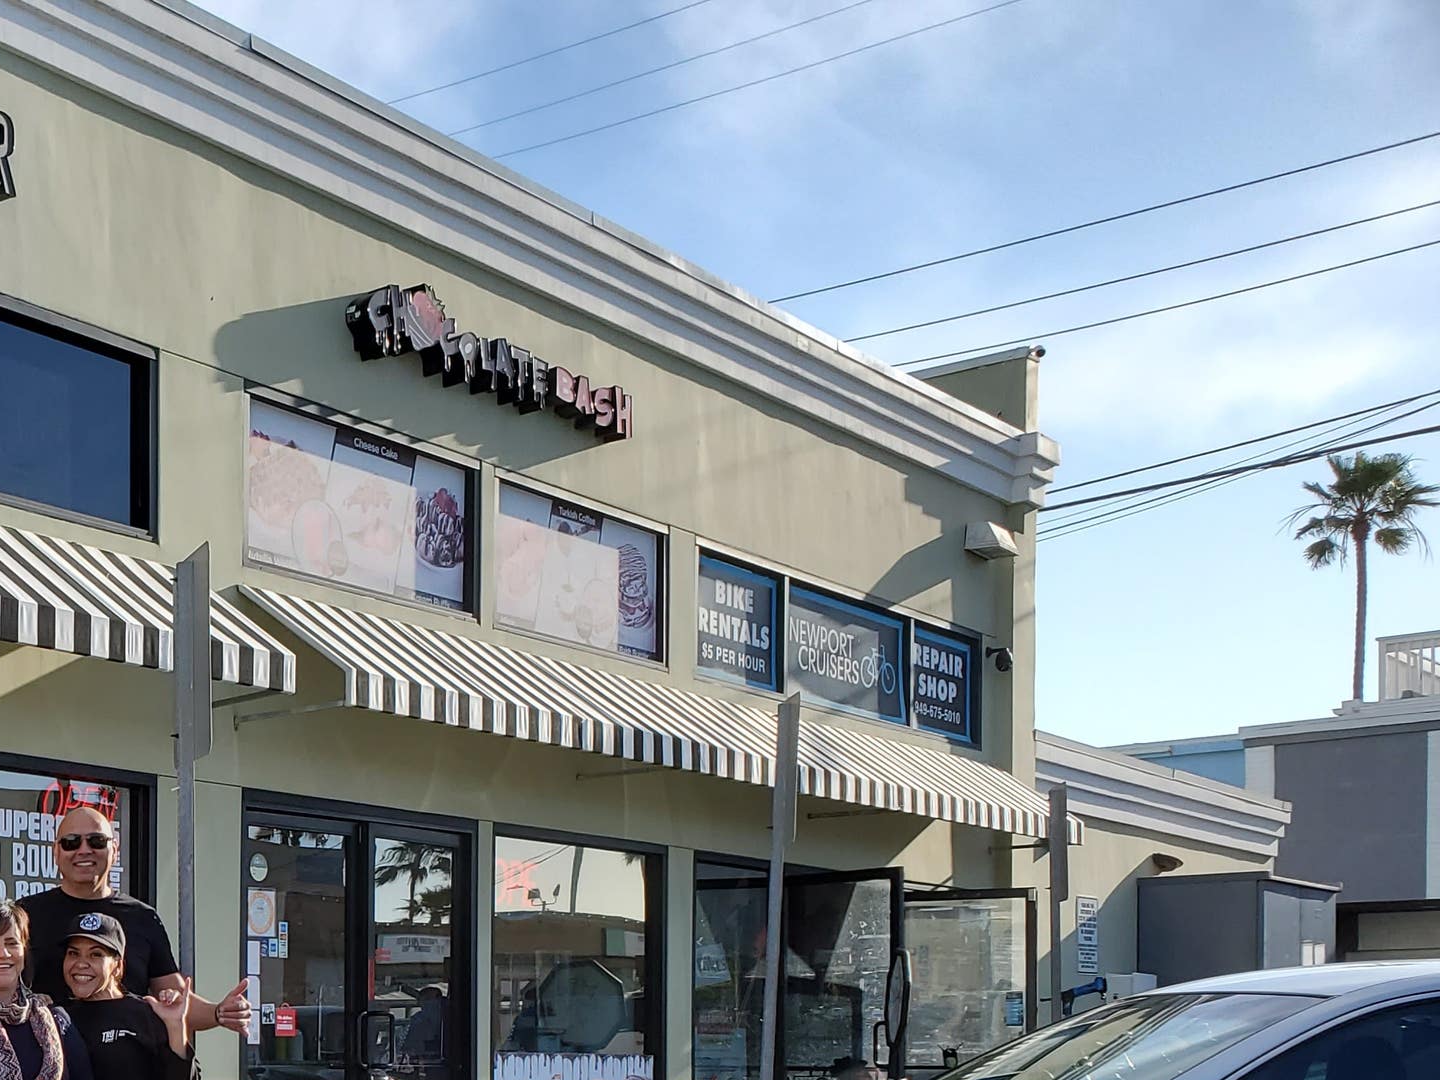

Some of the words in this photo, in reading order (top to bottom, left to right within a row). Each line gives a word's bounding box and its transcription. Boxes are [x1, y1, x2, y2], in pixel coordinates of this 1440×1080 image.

[550, 366, 633, 440] BASH
[353, 437, 380, 455] Cheese
[380, 446, 399, 461] Cake
[715, 579, 754, 614] BIKE
[698, 608, 770, 650] RENTALS
[789, 616, 855, 657] NEWPORT
[701, 641, 714, 660] $5
[716, 646, 736, 666] PER
[738, 652, 766, 674] HOUR
[798, 648, 860, 686] CRUISERS
[912, 643, 964, 680] REPAIR
[917, 672, 958, 704] SHOP
[43, 782, 120, 823] OPEN
[12, 842, 63, 880] BOW
